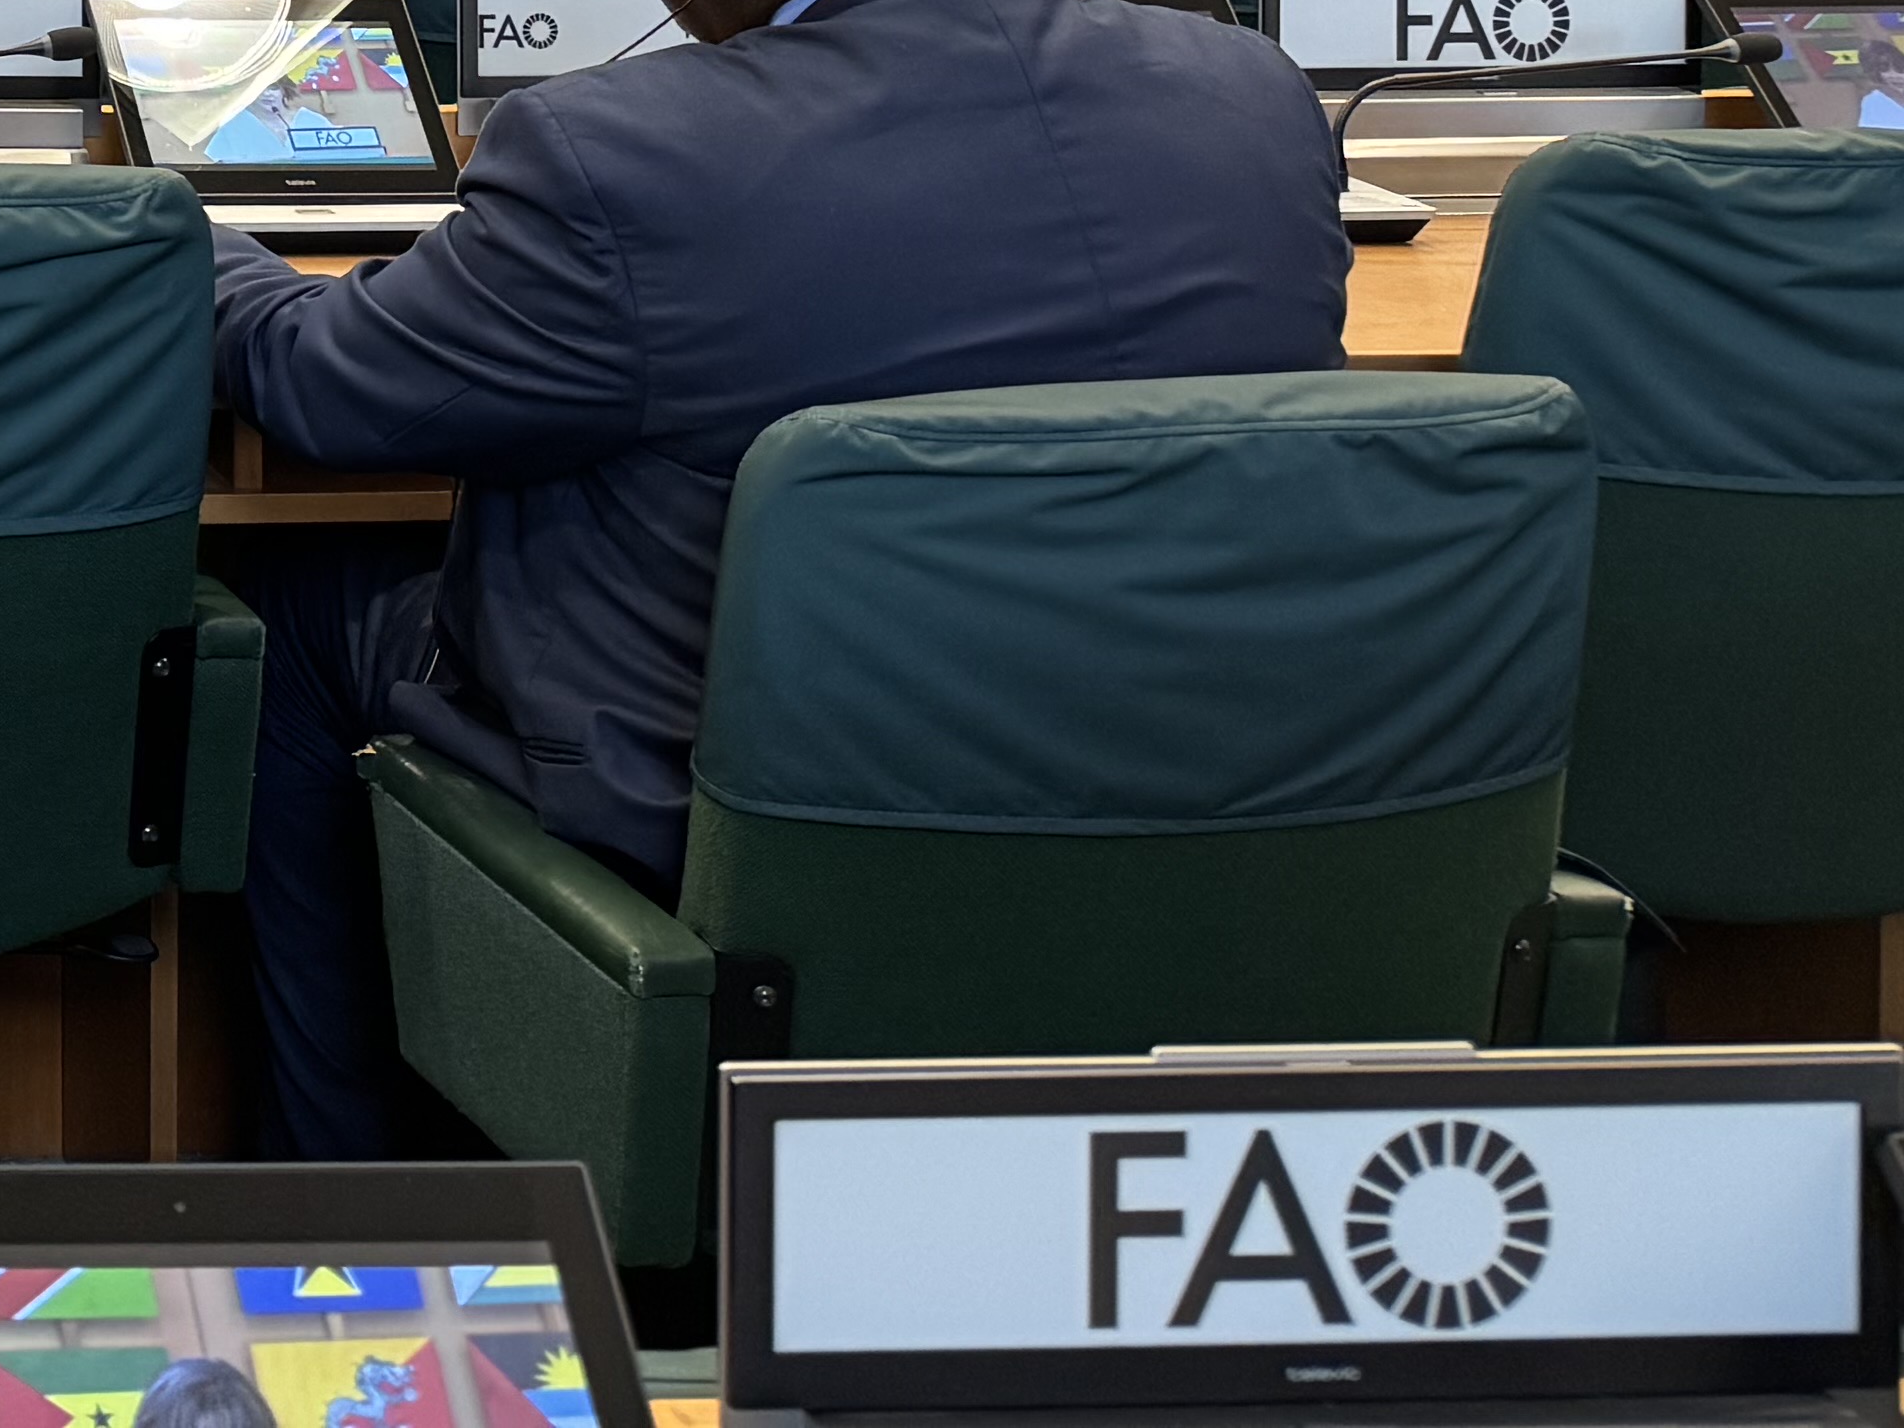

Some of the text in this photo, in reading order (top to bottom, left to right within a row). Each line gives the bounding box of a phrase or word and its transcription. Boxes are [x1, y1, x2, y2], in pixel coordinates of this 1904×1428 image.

[476, 12, 558, 51] FAO
[315, 131, 353, 146] FAO
[1088, 1118, 1552, 1331] FAO
